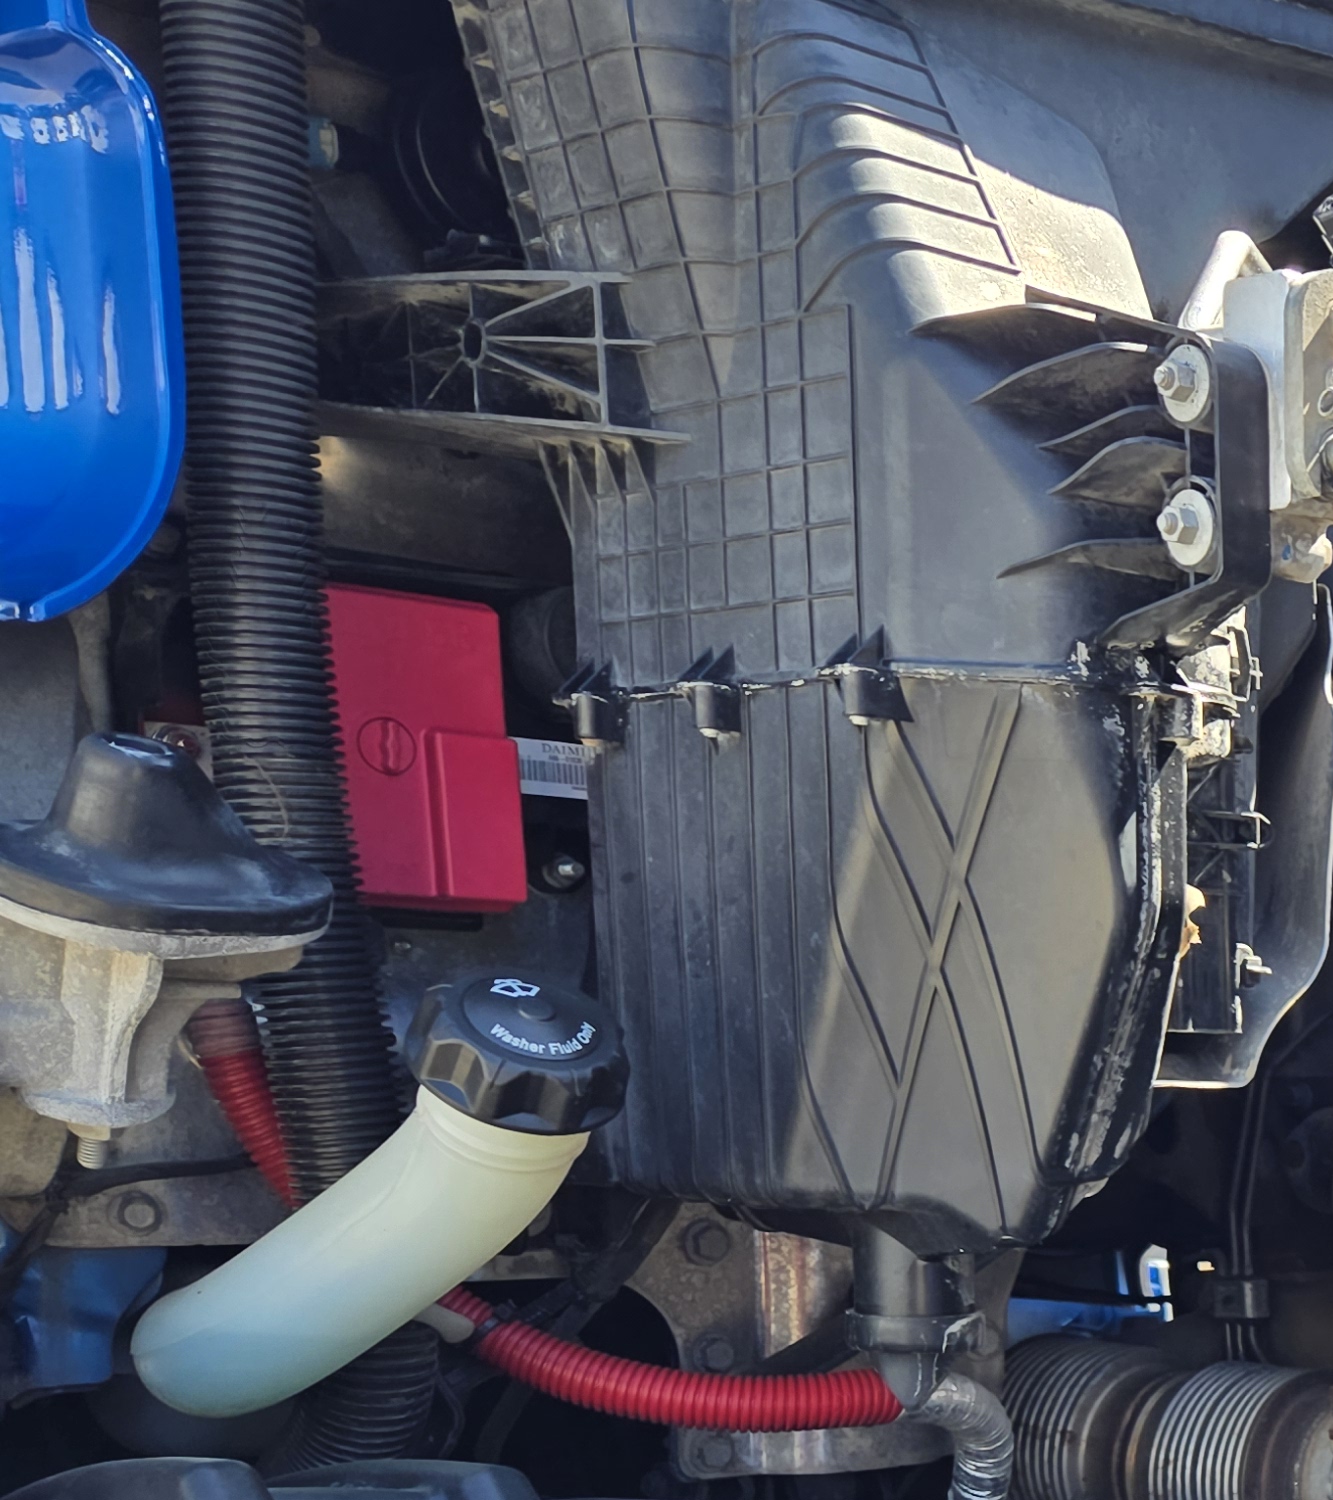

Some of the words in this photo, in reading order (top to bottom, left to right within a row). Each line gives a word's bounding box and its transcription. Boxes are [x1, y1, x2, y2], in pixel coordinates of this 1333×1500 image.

[490, 1023, 546, 1054] Washer
[548, 1037, 583, 1055] Fluid
[576, 1021, 597, 1044] Only
